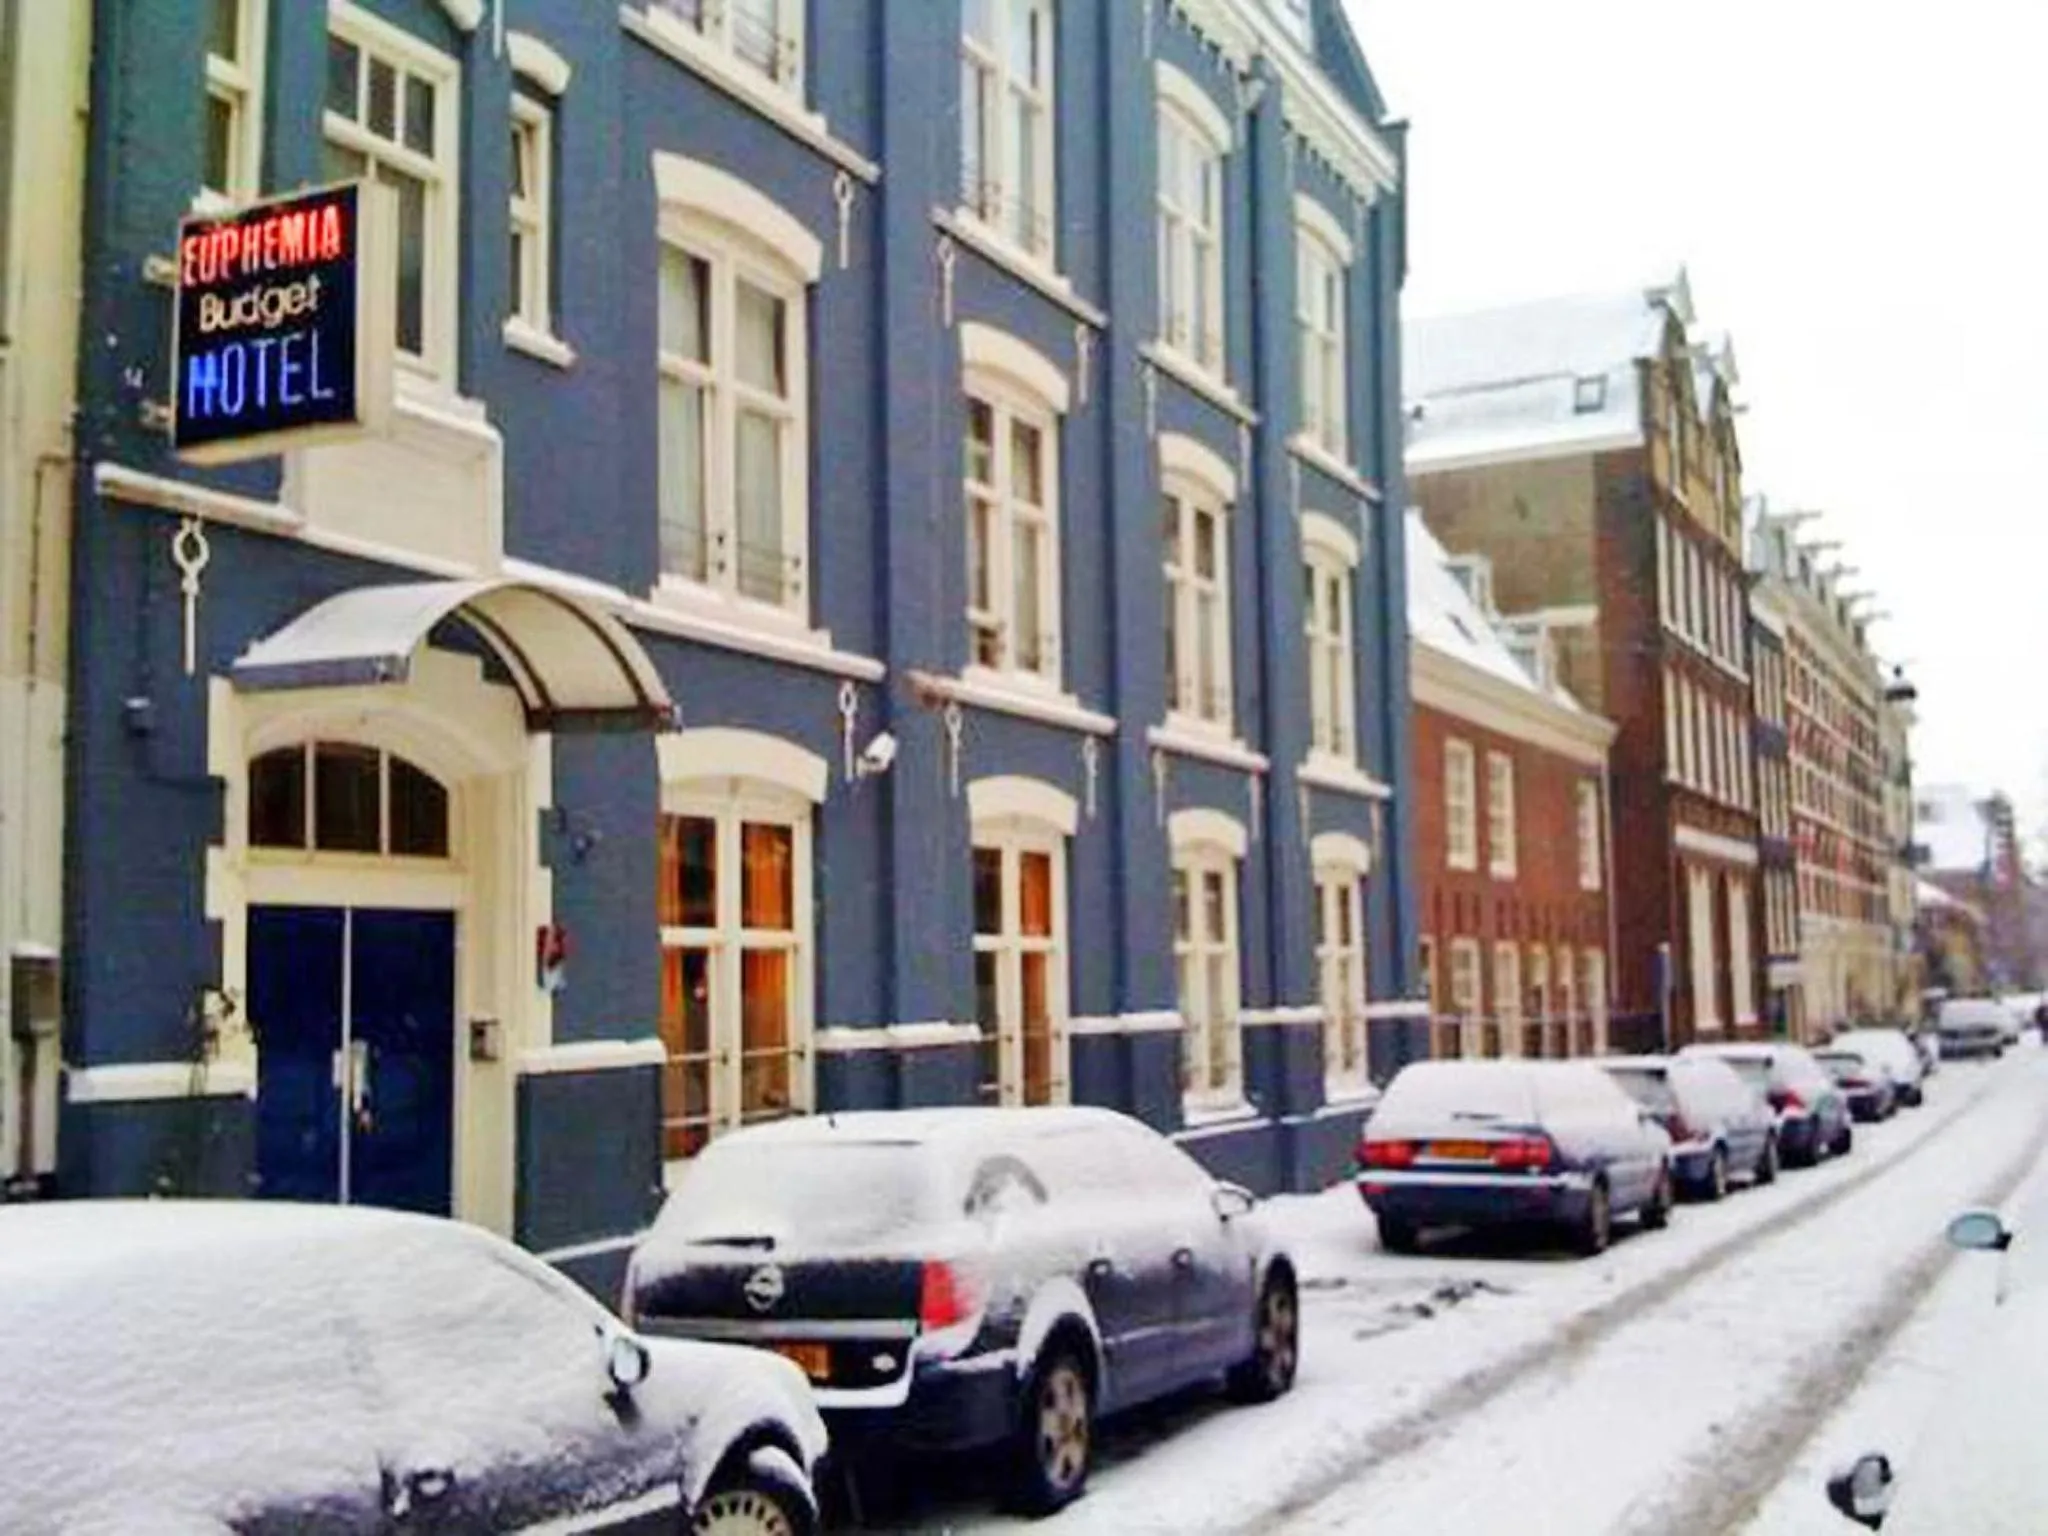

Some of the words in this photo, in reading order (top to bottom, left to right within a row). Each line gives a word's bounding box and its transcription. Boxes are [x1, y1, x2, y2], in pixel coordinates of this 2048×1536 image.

[182, 205, 341, 286] EUPHEMIA
[199, 273, 321, 333] Budget
[188, 328, 335, 418] HOTEL
